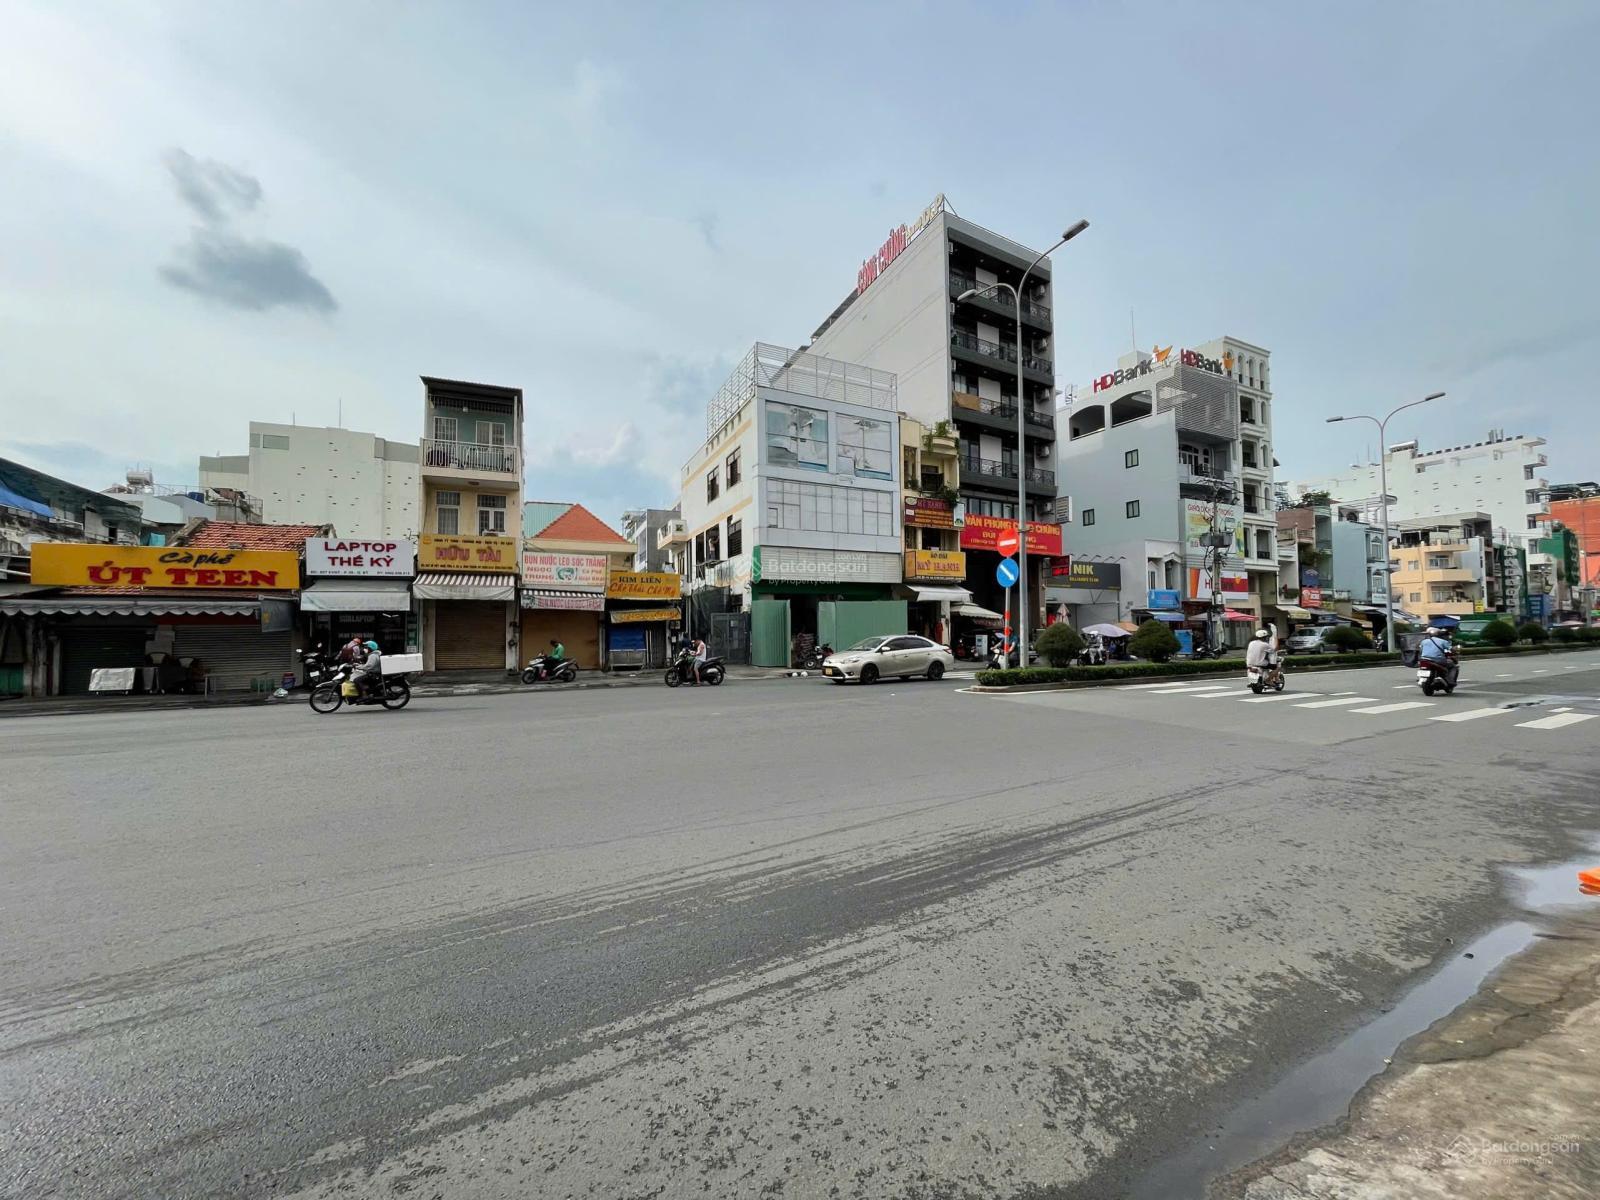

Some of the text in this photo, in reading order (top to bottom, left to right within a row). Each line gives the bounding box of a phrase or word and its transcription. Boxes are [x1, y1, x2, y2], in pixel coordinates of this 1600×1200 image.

[1180, 348, 1224, 375] HDBank
[1093, 359, 1154, 393] HDBank
[324, 541, 397, 552] LAPTOP
[159, 552, 235, 568] Cà phê
[165, 567, 279, 586] TEEN
[1073, 564, 1094, 575] NIK
[619, 575, 637, 583] KIM
